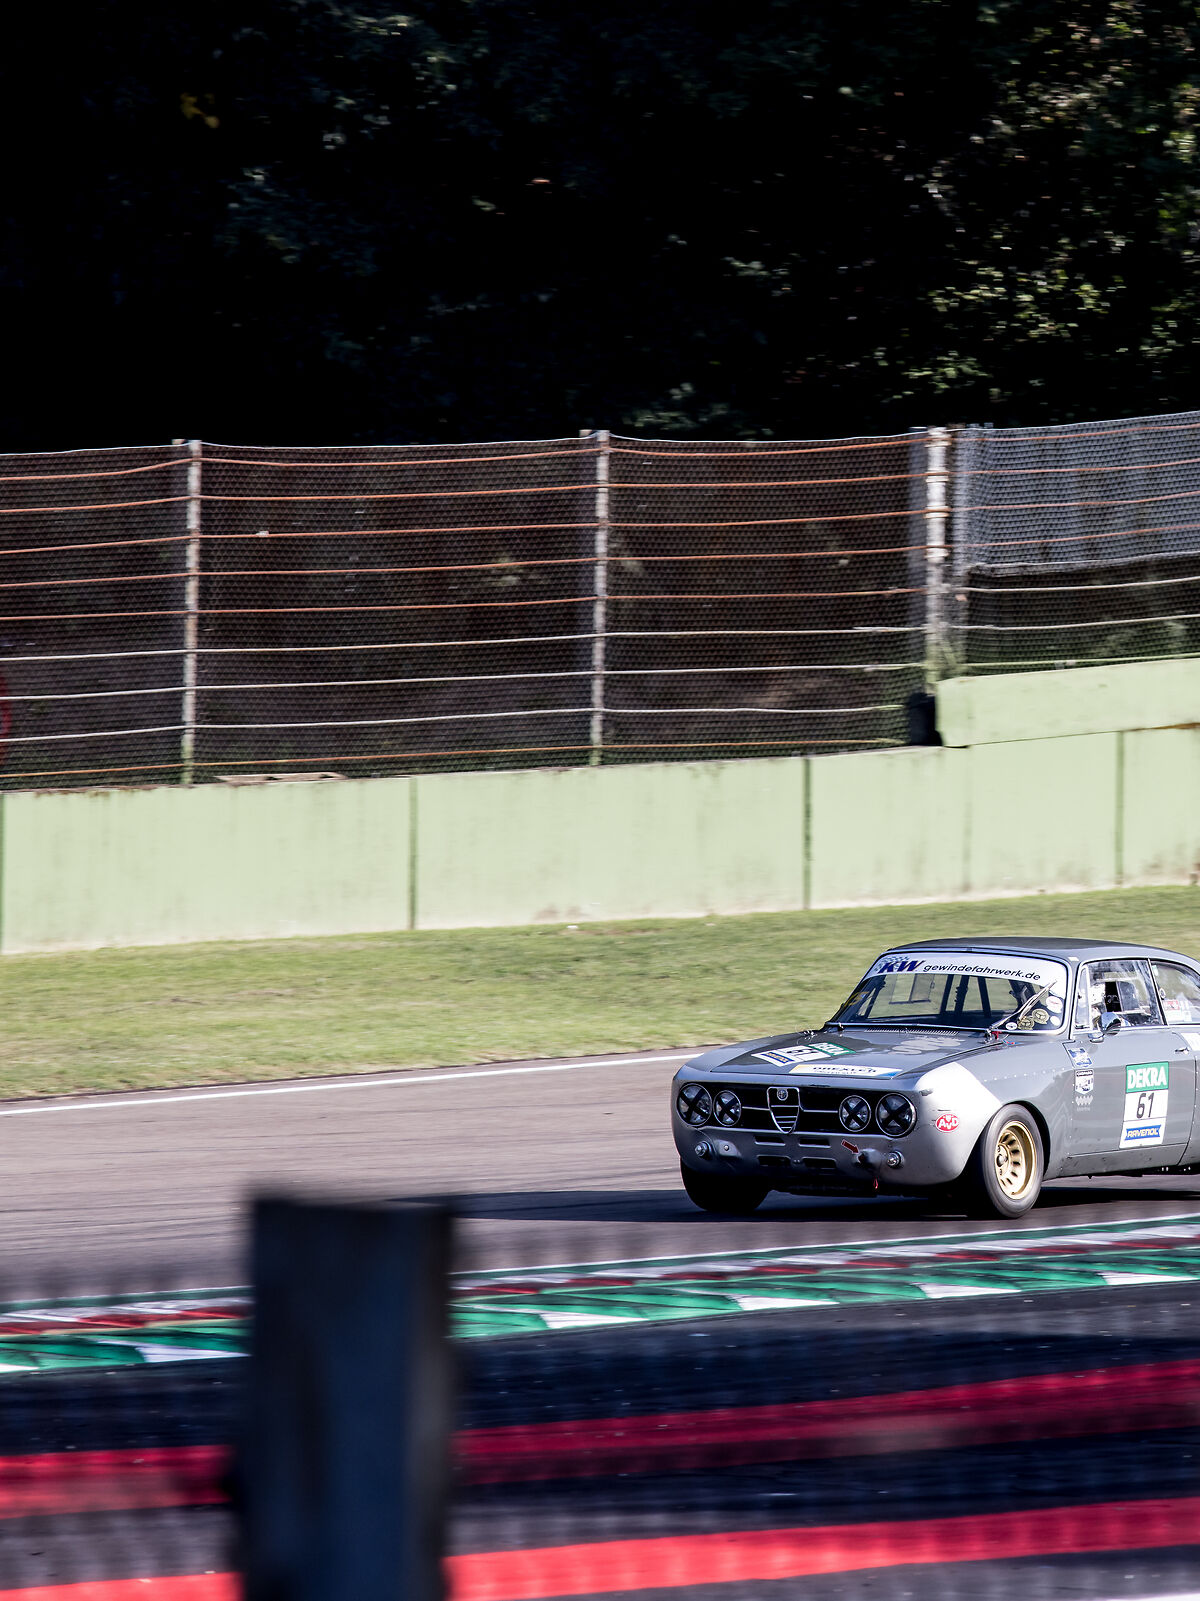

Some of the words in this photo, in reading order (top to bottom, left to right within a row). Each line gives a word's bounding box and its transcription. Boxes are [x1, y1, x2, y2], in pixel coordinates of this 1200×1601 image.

[877, 959, 926, 974] KW
[923, 963, 1041, 981] gewindefahrwerk.de
[1127, 1066, 1168, 1090] DEKRA
[1136, 1092, 1155, 1119] 61
[1127, 1127, 1161, 1139] RAVENOL
